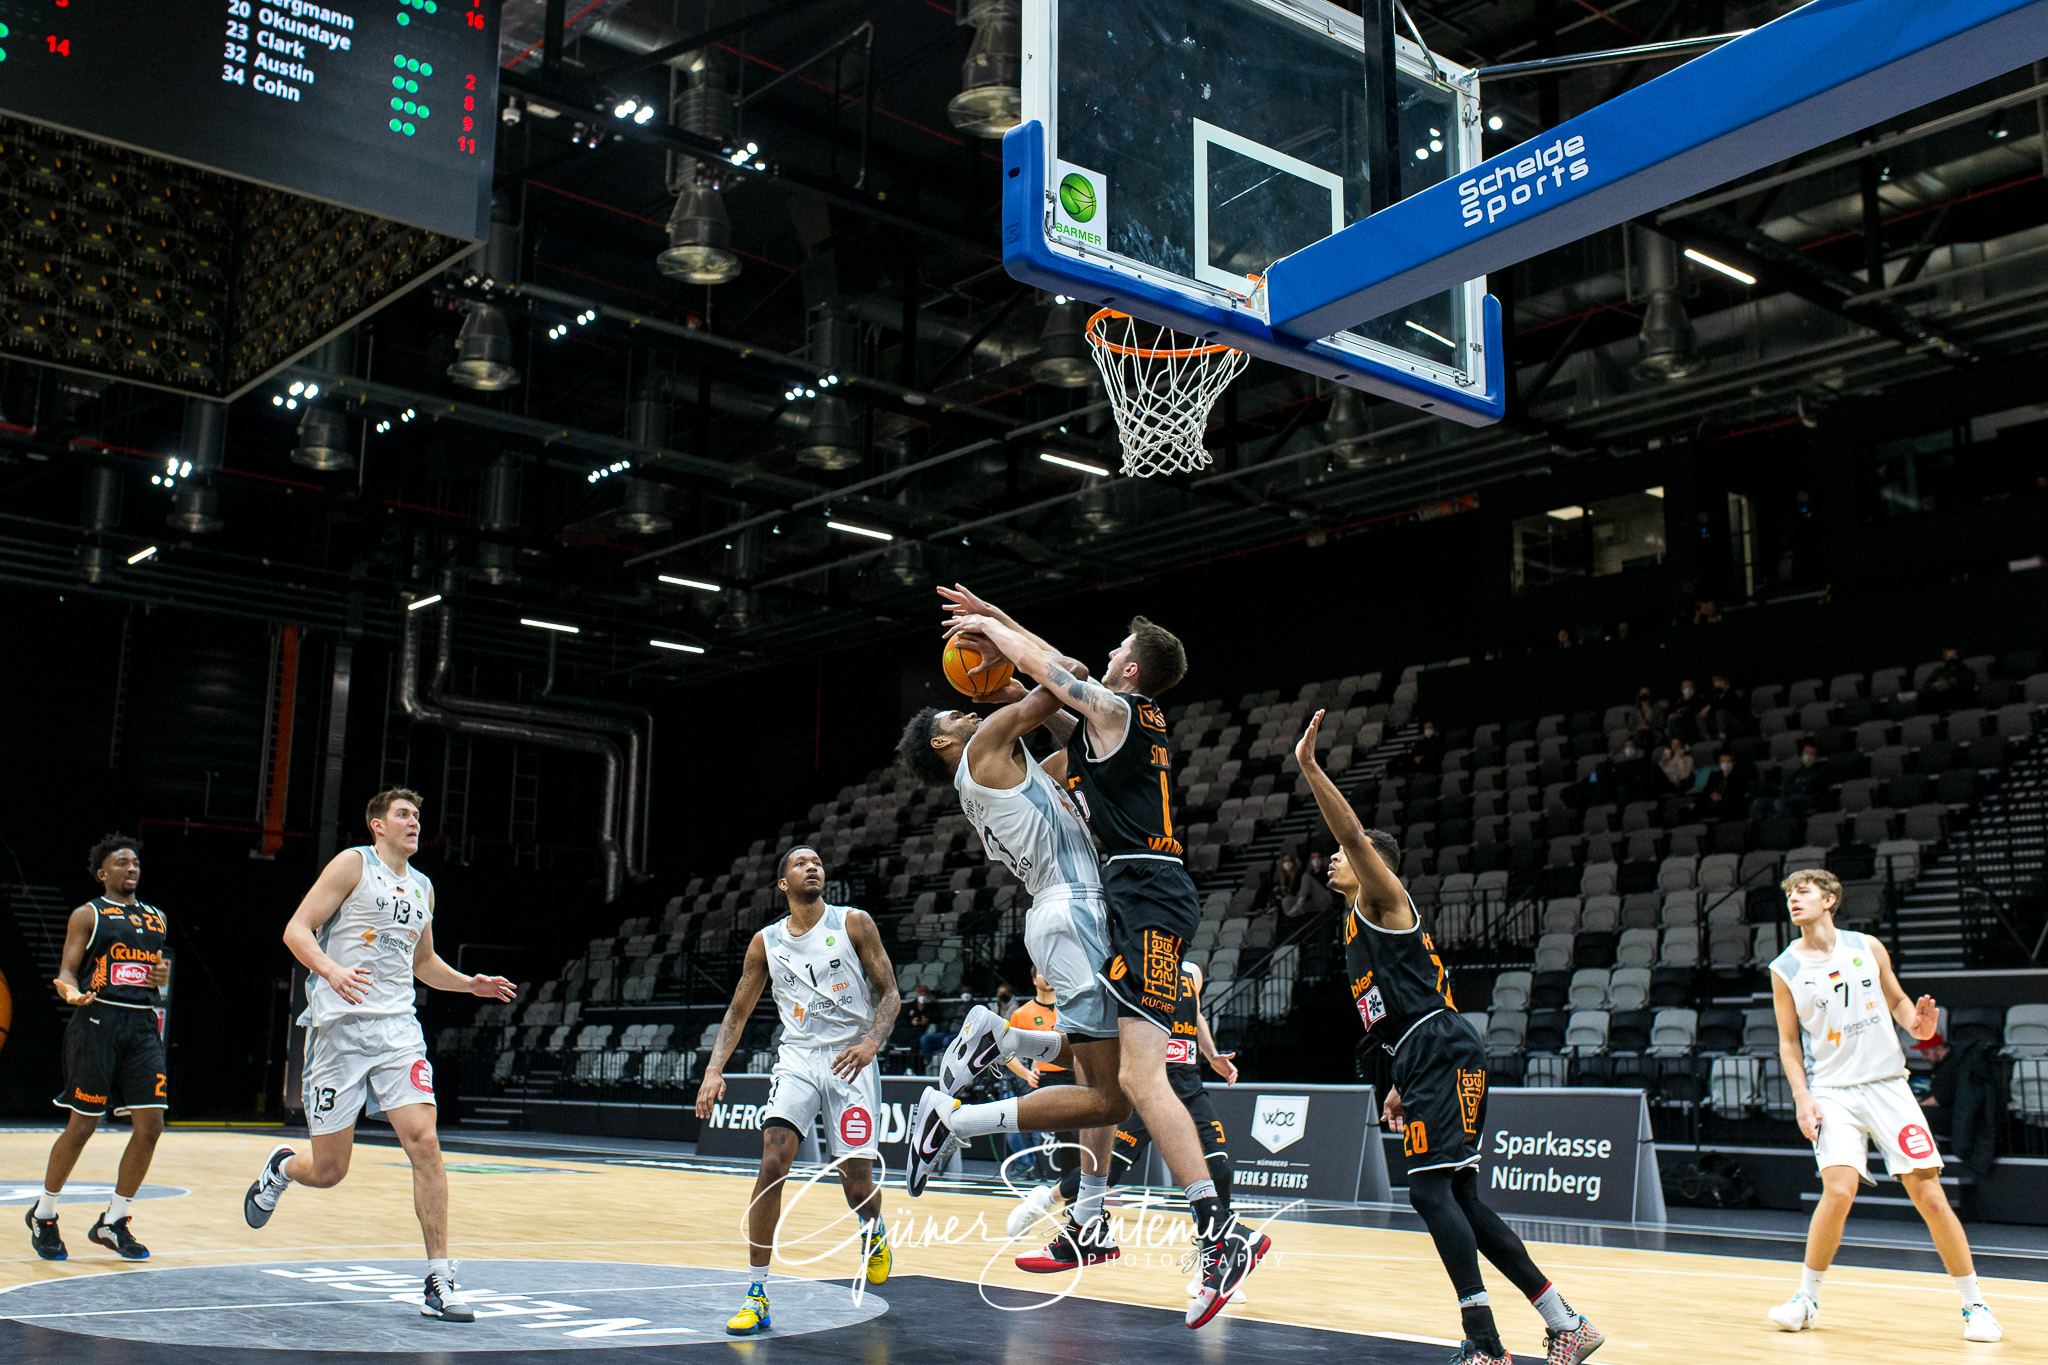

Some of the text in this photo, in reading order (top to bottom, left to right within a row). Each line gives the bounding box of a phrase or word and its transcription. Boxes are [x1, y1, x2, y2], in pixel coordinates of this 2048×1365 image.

[262, 0, 354, 30] ergmann
[465, 11, 484, 30] 16
[46, 35, 70, 57] 14
[228, 0, 476, 91] 20 Okundaye 2
[226, 20, 475, 112] 23 Clark 8
[224, 42, 474, 132] 32 Austin 9
[222, 64, 475, 155] 34 Cohn 11
[1458, 135, 1586, 206] Schelde
[1462, 157, 1590, 228] Sports
[1055, 222, 1102, 246] BARMER
[141, 912, 165, 935] 23
[392, 895, 411, 925] 13
[116, 968, 147, 980] Helios
[805, 963, 817, 988] 1
[1141, 995, 1176, 1015] KÜCHEN
[1834, 981, 1849, 1007] 7
[314, 1086, 337, 1113] 13
[1403, 1120, 1429, 1158] 20
[1493, 1130, 1612, 1160] Sparkasse
[1270, 1171, 1309, 1190] EVENTS
[1490, 1165, 1602, 1201] Nürnberg
